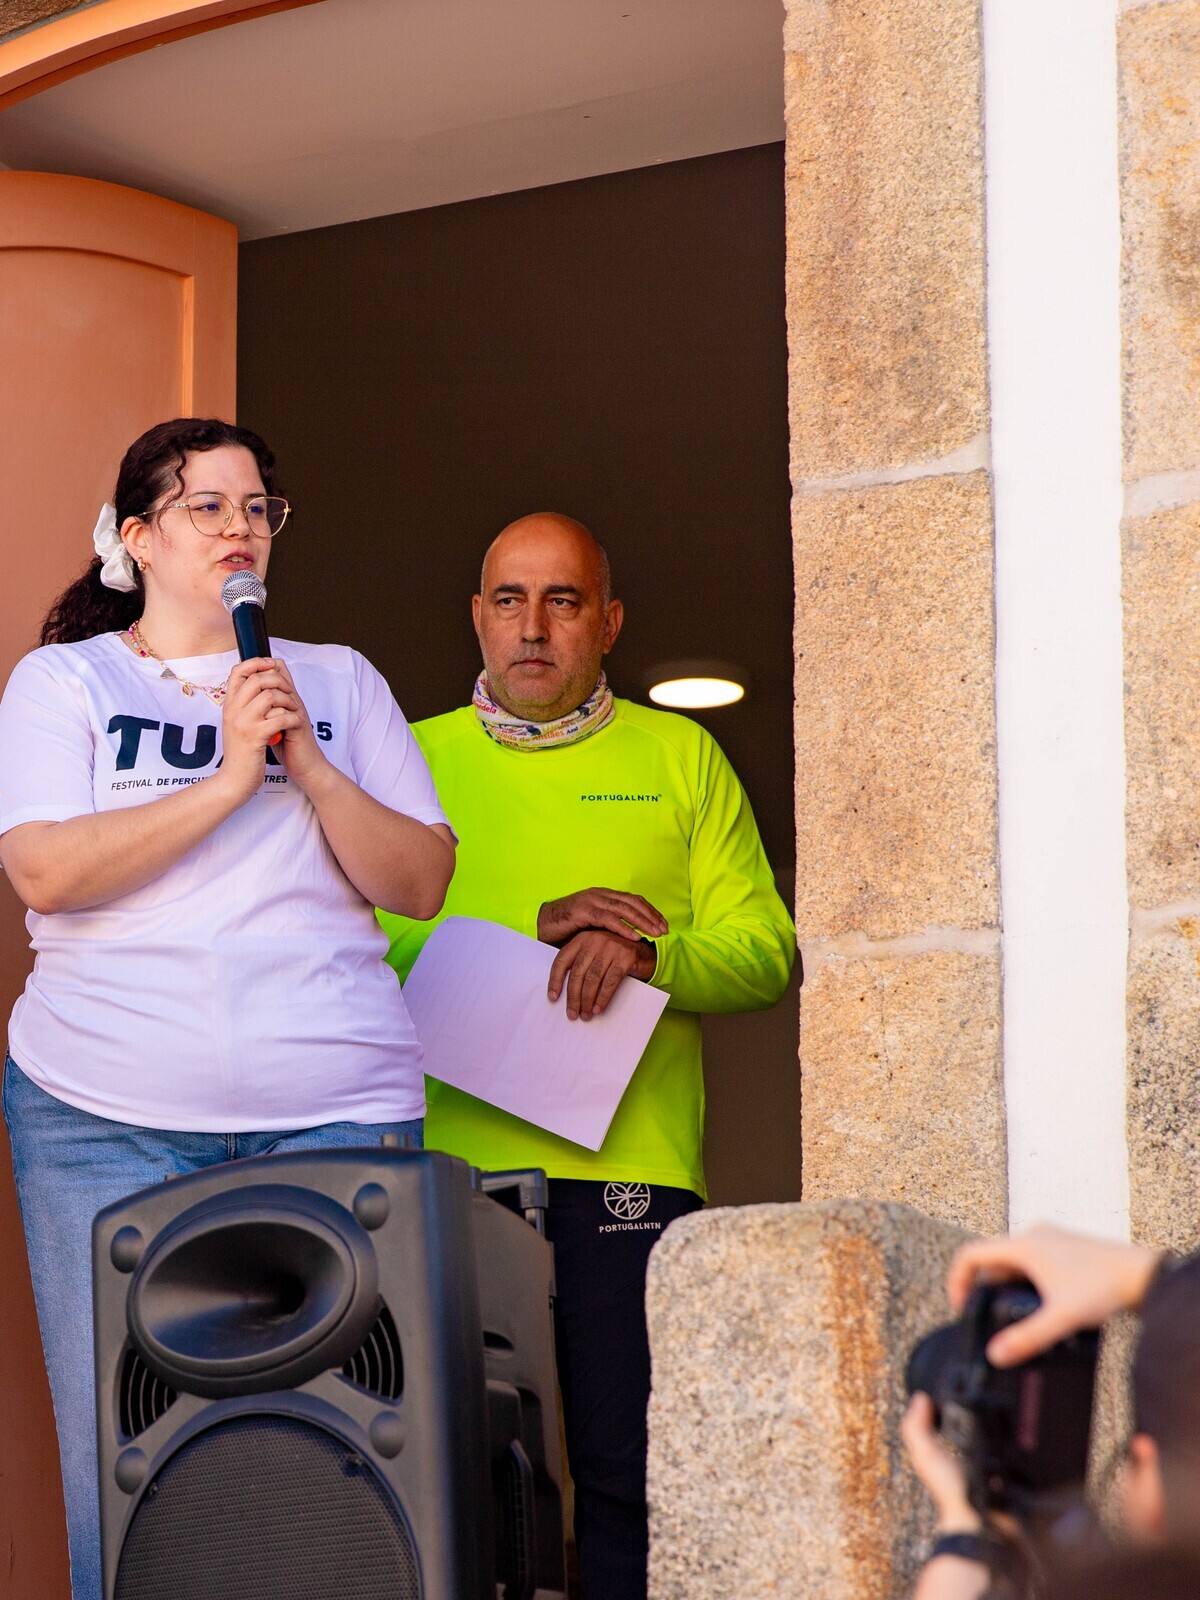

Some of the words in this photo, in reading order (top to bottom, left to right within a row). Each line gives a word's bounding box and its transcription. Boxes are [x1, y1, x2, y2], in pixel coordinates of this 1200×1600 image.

[111, 778, 153, 791] FESTIVAL
[156, 778, 170, 786] DE
[264, 774, 288, 784] TRES
[581, 794, 659, 802] PORTUGALNTN
[599, 1222, 661, 1233] PORTUGALNTN
